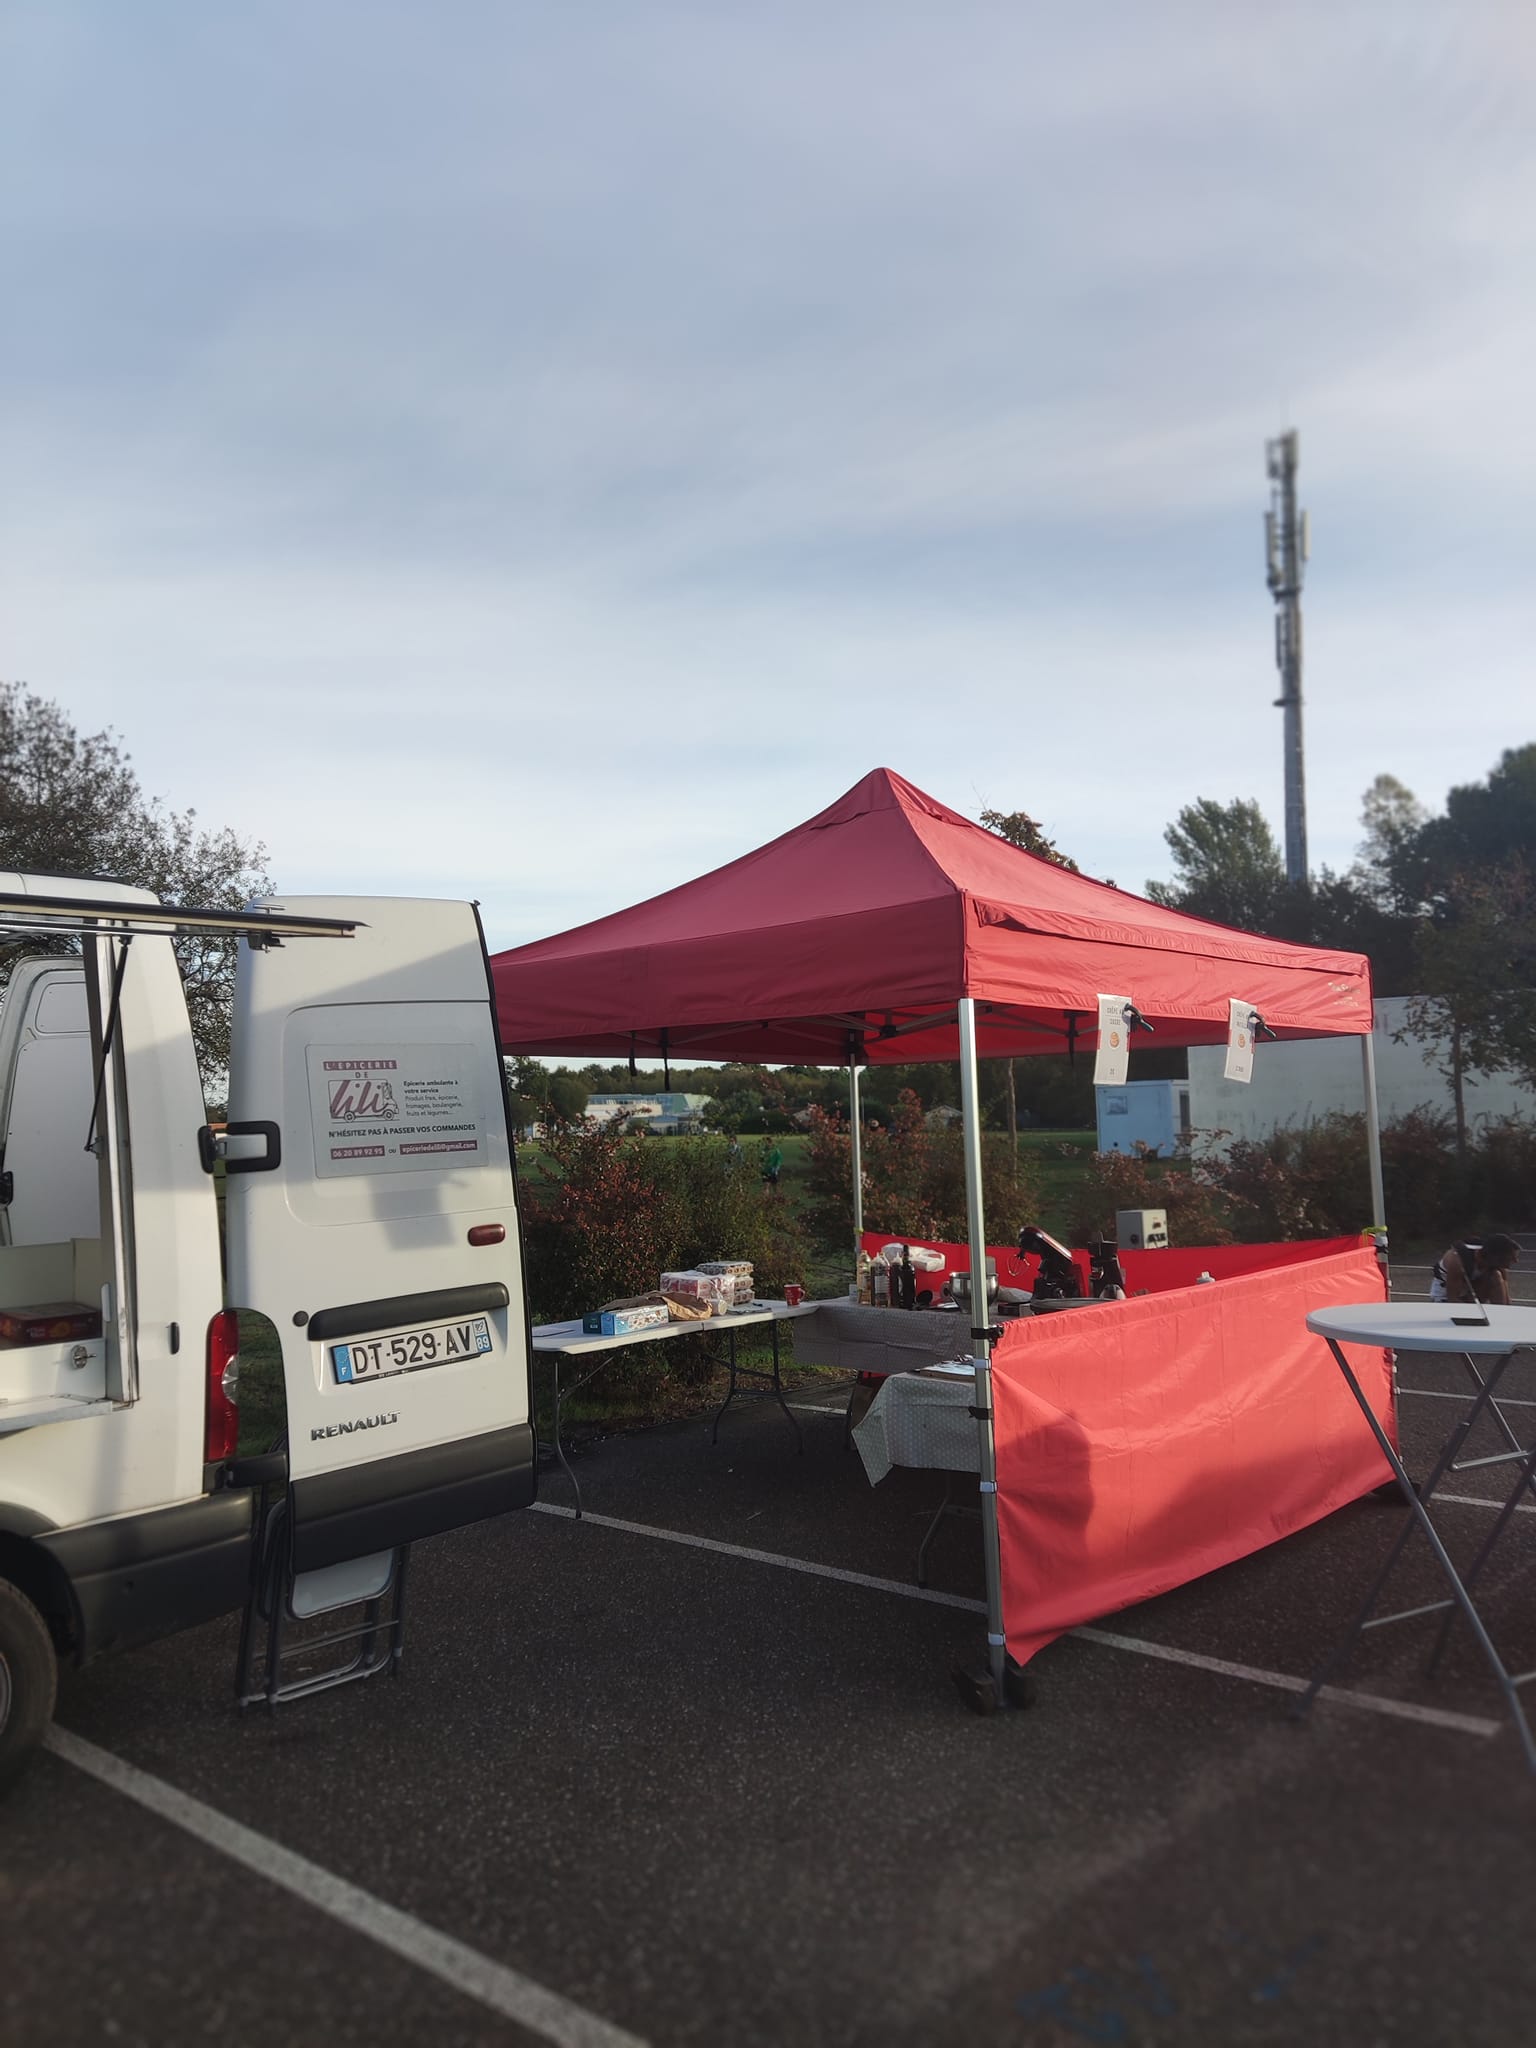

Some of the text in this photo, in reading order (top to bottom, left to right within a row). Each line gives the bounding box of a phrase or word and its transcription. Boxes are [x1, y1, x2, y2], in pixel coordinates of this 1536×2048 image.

[328, 1122, 476, 1138] N'HÉSITEZ PAS À PASSER VOS COMMANDES
[332, 1150, 343, 1158] 06
[352, 1325, 470, 1374] DT-529-AV
[476, 1335, 490, 1350] 89
[341, 1366, 347, 1376] F
[311, 1411, 400, 1441] RENAULT
